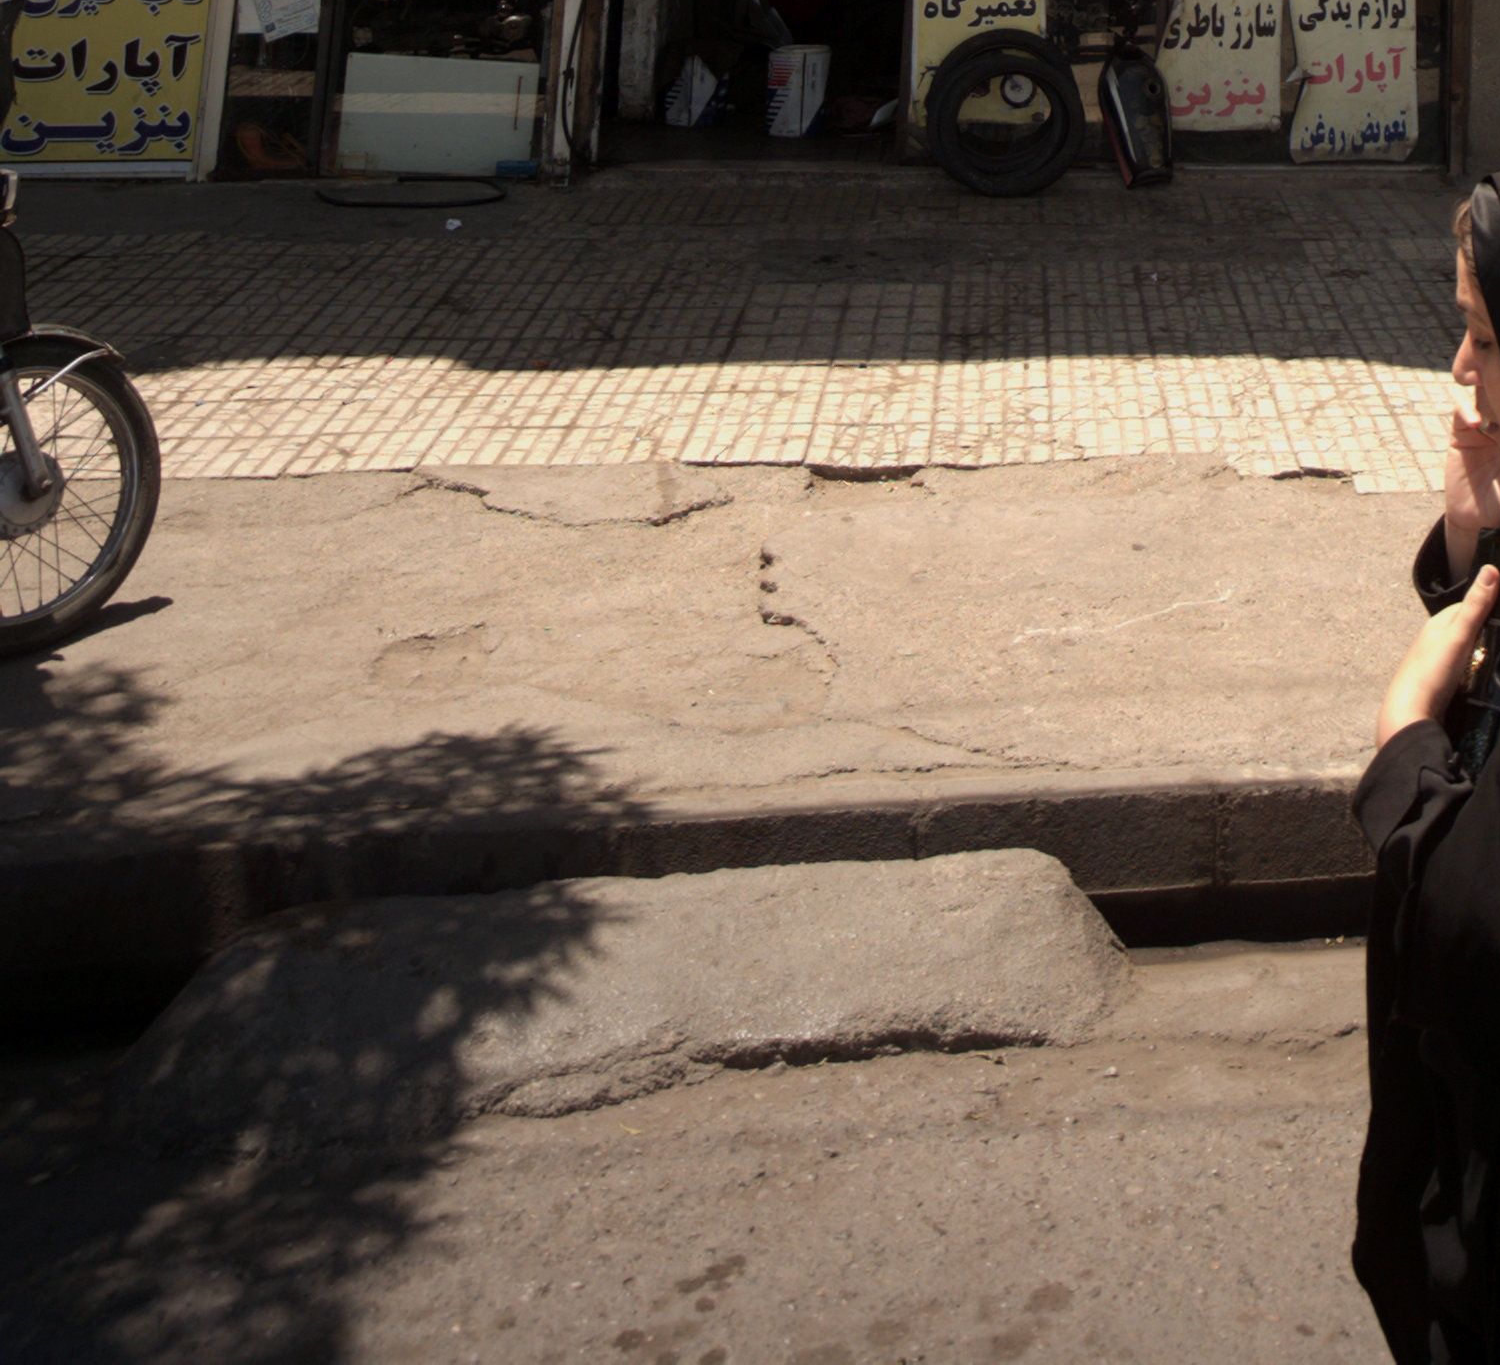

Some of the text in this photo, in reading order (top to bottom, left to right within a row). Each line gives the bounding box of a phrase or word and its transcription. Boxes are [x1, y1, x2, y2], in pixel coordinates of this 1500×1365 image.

[1164, 2, 1278, 51] شارژ باطری
[12, 32, 202, 96] آپارات
[1305, 47, 1405, 95] آپارات
[1169, 79, 1267, 119] بنزین
[1, 104, 193, 156] بنزین
[1299, 114, 1408, 154] تعویض روغن
